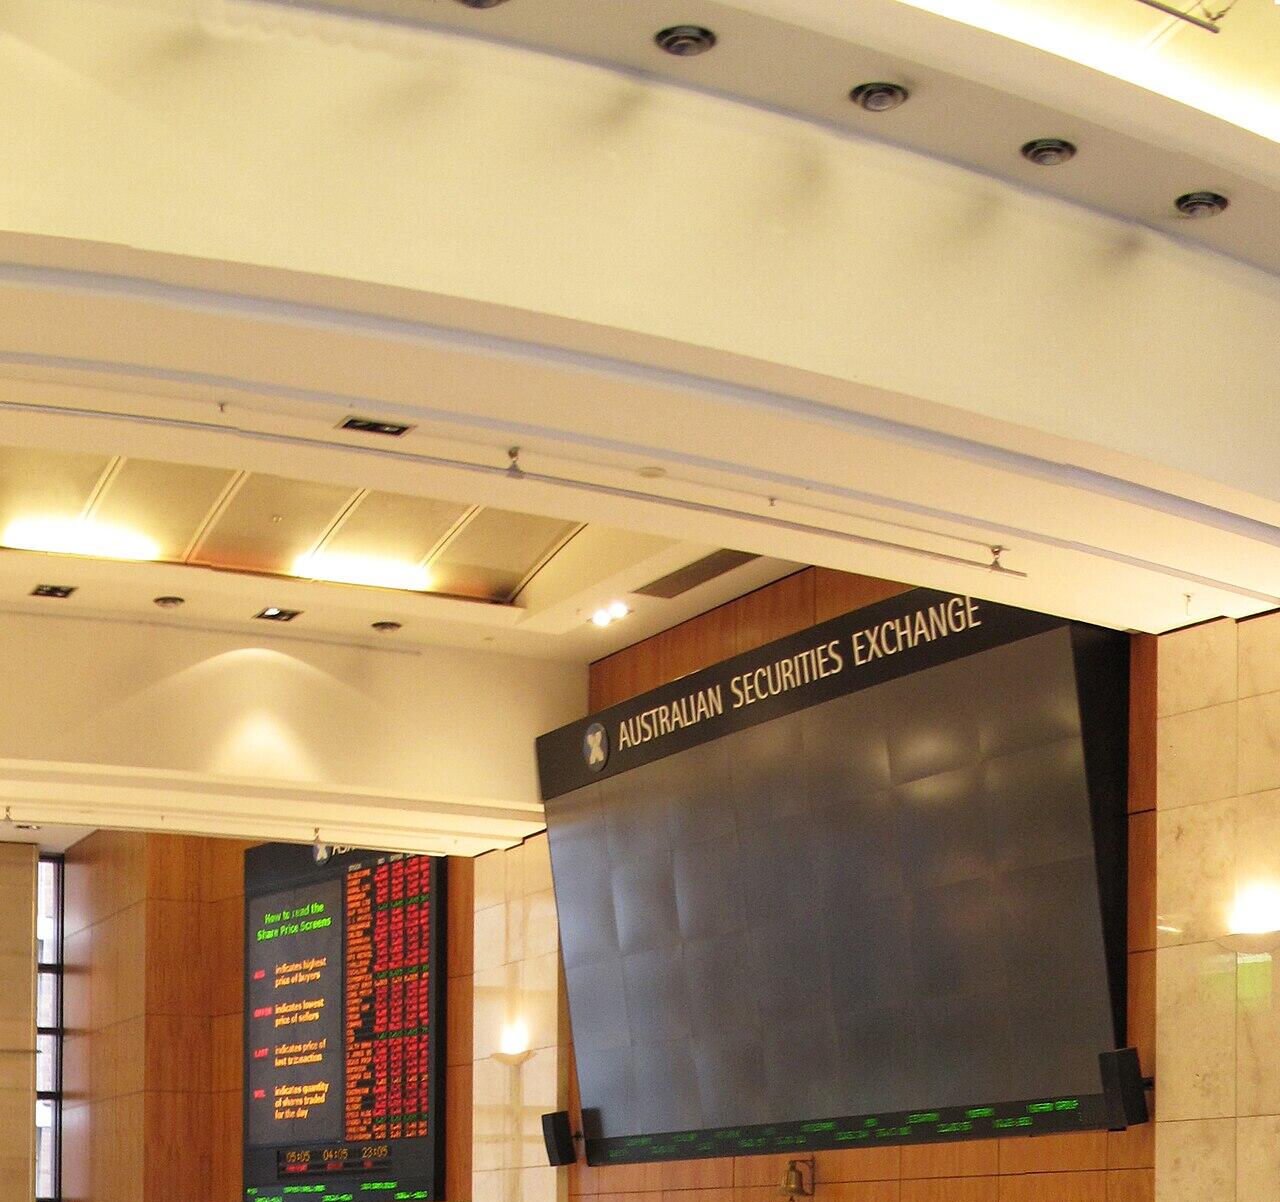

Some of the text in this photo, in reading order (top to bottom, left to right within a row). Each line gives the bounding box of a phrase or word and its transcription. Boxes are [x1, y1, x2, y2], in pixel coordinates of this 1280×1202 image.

[619, 596, 982, 752] AUSTRALIAN SECURITIES EXCHANGE
